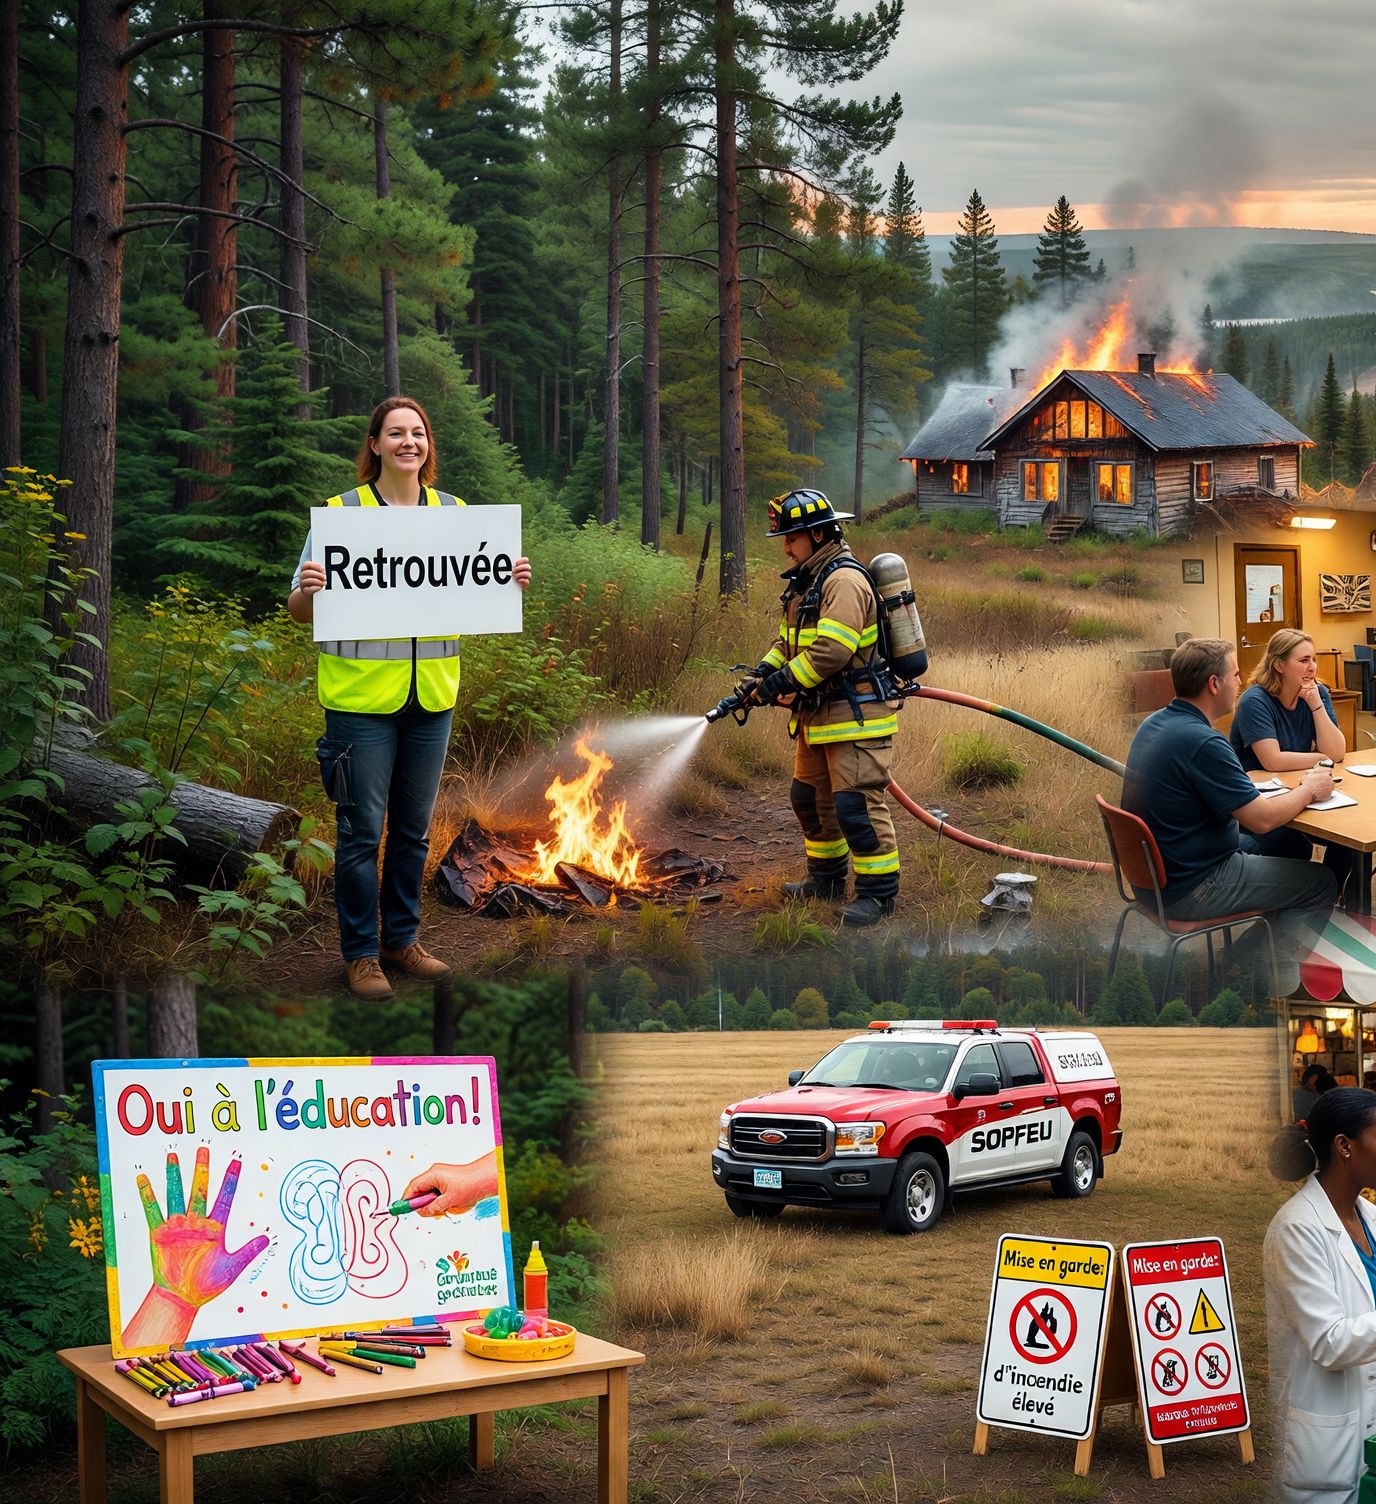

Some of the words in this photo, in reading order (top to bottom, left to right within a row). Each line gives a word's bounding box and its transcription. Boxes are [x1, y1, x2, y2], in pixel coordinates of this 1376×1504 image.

[324, 541, 513, 590] Retrouvée
[117, 1083, 196, 1136] Oui
[211, 1082, 241, 1133] à
[254, 1076, 481, 1131] l'éducation!
[970, 1120, 1053, 1153] SOPFEU
[1003, 1249, 1035, 1269] Mise
[1039, 1258, 1056, 1271] en
[1133, 1257, 1161, 1274] Mise
[1162, 1259, 1178, 1271] en
[1012, 1391, 1055, 1416] élevé
